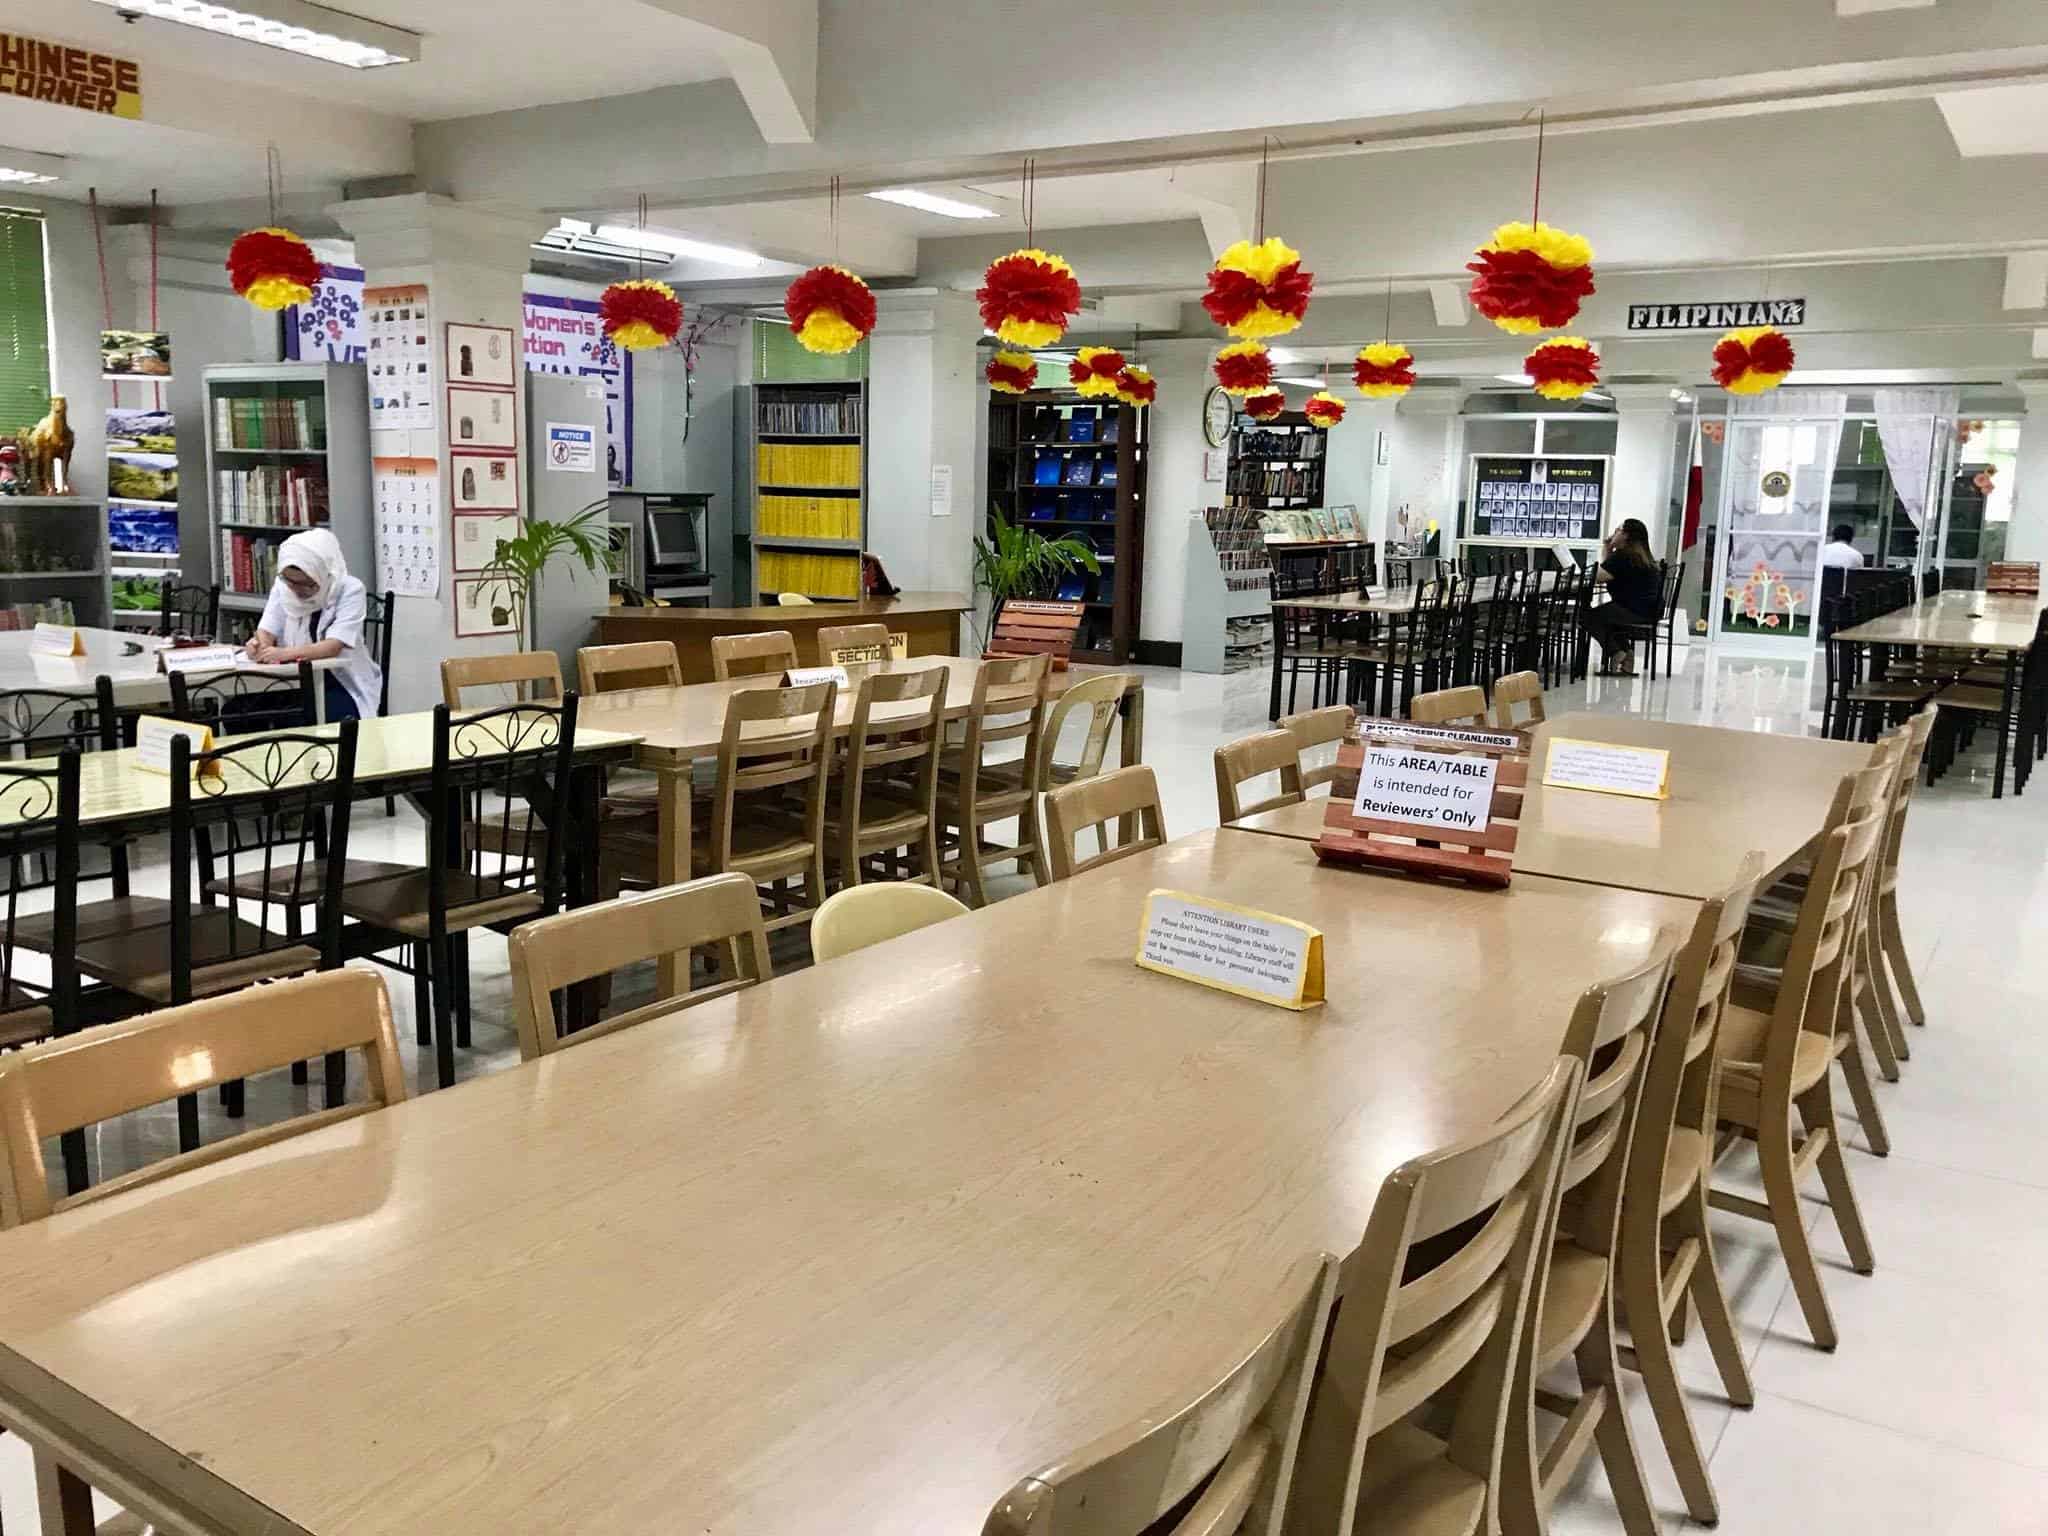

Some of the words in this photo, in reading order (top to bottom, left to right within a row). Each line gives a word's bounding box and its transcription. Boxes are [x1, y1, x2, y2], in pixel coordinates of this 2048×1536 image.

[0, 33, 139, 94] HINESE
[1630, 301, 1802, 328] FILIPINIANA
[837, 649, 881, 663] SECTIO
[1447, 732, 1512, 746] CLEANLINESS
[1370, 753, 1395, 767] This
[1398, 757, 1488, 778] AREA/TABLE
[1373, 777, 1384, 789] is
[1387, 778, 1449, 798] intended
[1453, 786, 1474, 800] for
[1442, 808, 1476, 827] Only
